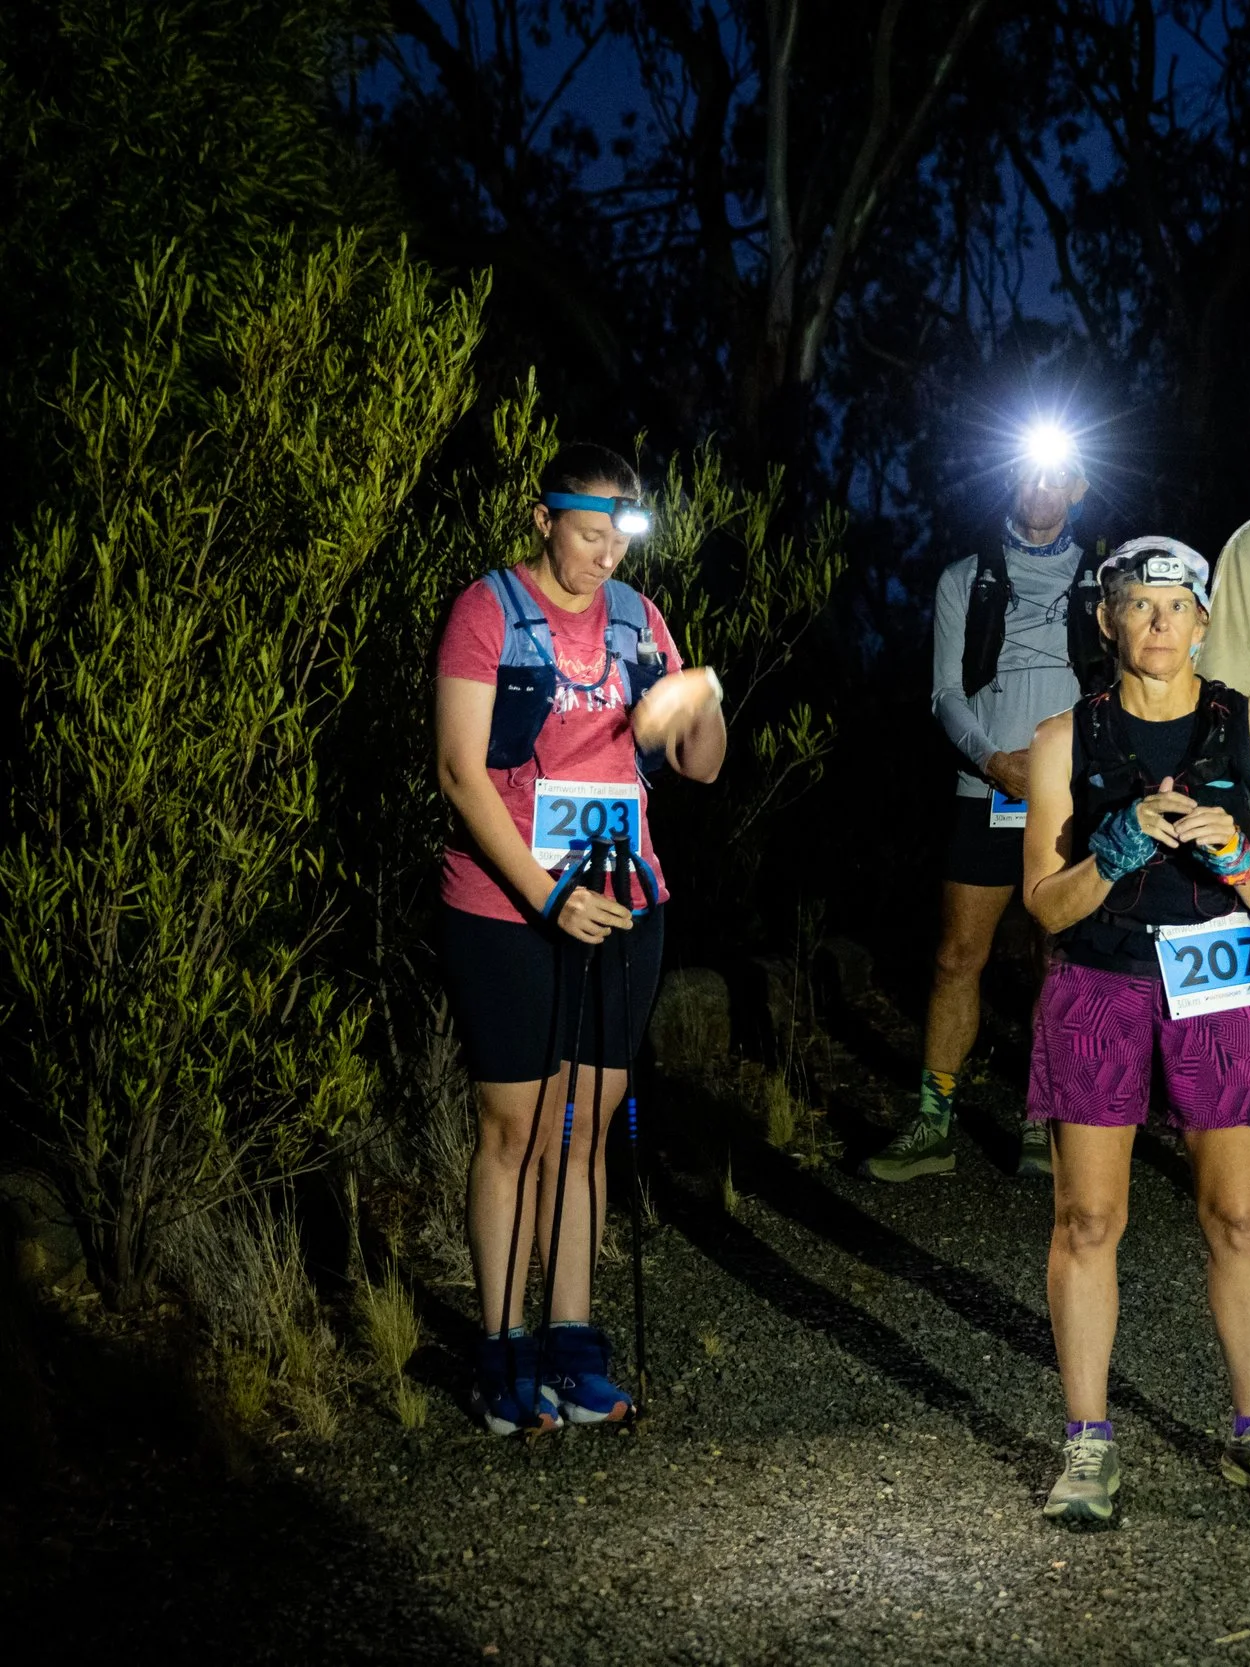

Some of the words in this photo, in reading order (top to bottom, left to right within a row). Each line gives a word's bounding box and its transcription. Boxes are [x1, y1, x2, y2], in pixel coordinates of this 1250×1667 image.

[543, 783, 586, 794] Tamworth
[590, 785, 606, 796] Trail
[547, 799, 630, 837] 203
